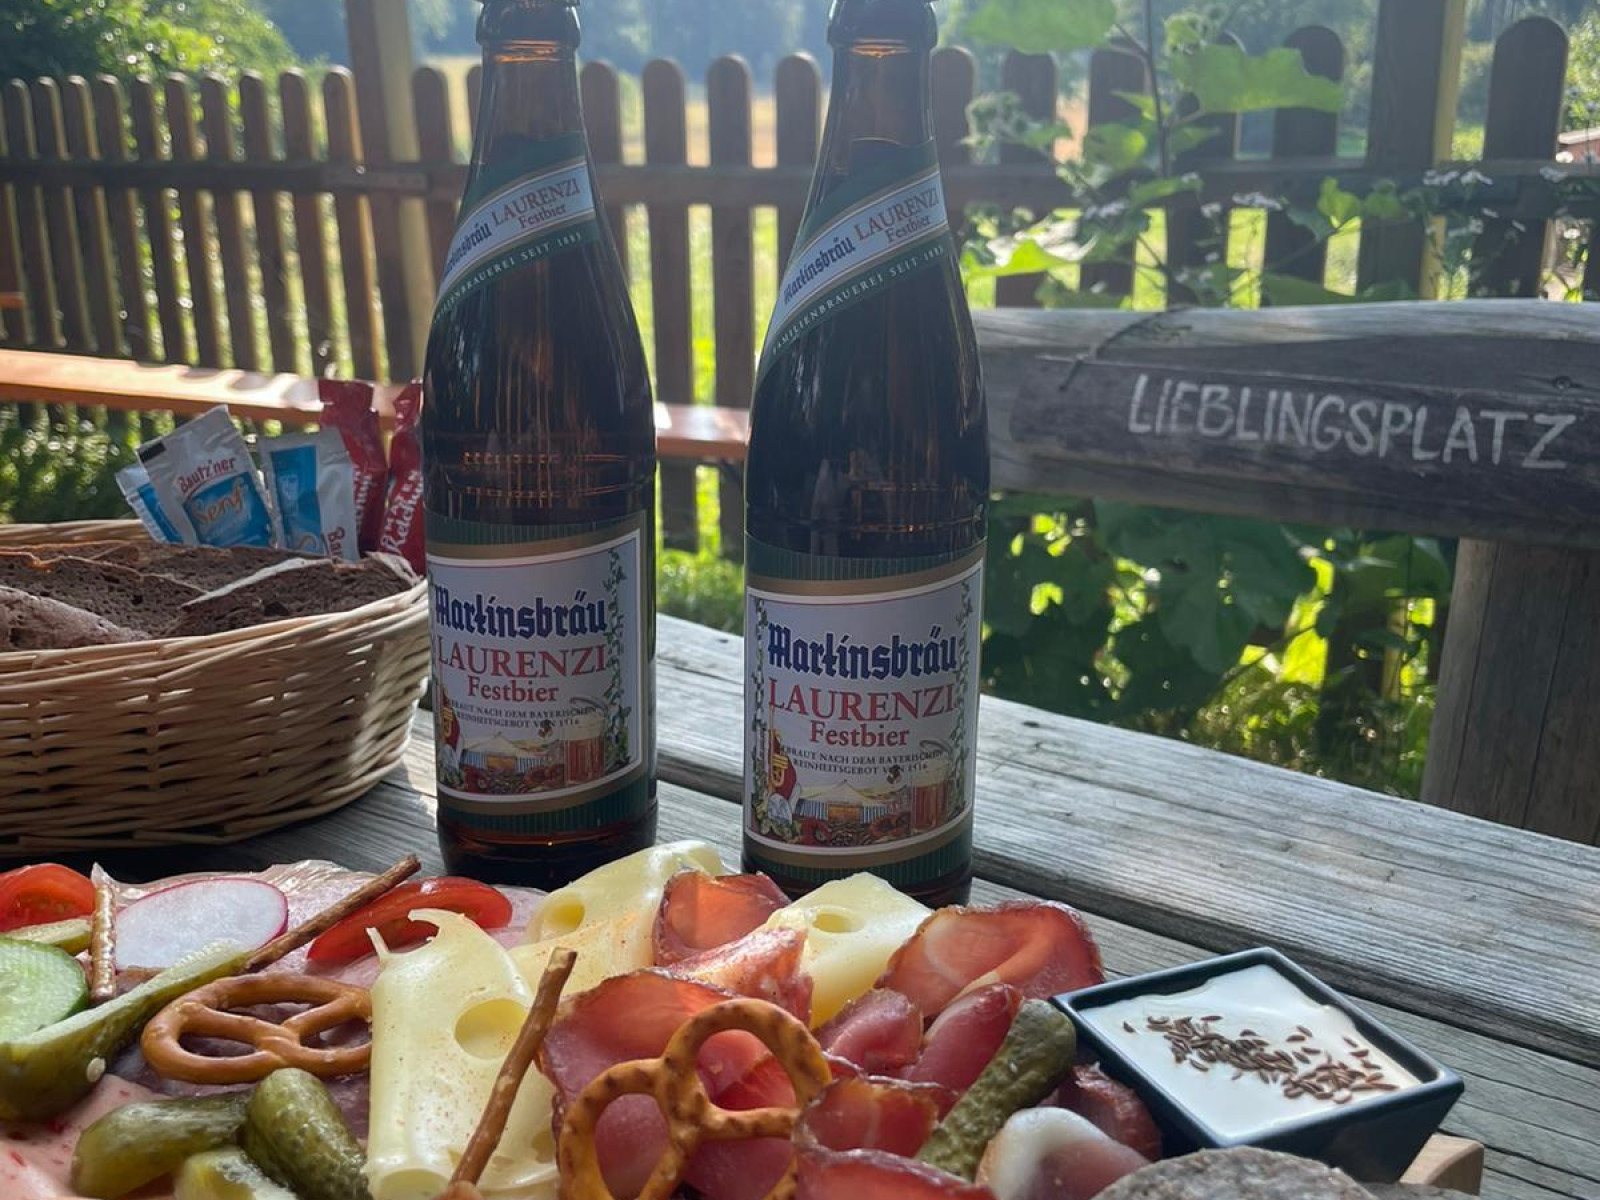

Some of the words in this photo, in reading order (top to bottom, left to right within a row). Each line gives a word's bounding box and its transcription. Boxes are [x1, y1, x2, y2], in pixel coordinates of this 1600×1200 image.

[491, 178, 581, 226] LAURENZI
[518, 204, 567, 229] Festbier
[885, 215, 931, 244] Festbier
[1128, 374, 1577, 469] LIEBLINGSPLATZ
[435, 586, 608, 639] Martinsbräu
[437, 635, 608, 678] LAURENZI
[768, 622, 957, 680] Martinsbräu
[468, 675, 560, 702] Festbier
[768, 677, 959, 721] LAURENZI
[476, 706, 502, 718] NACH
[504, 709, 527, 719] DEM
[810, 720, 909, 747] Festbier
[820, 752, 849, 764] NACH
[852, 755, 876, 765] DEM
